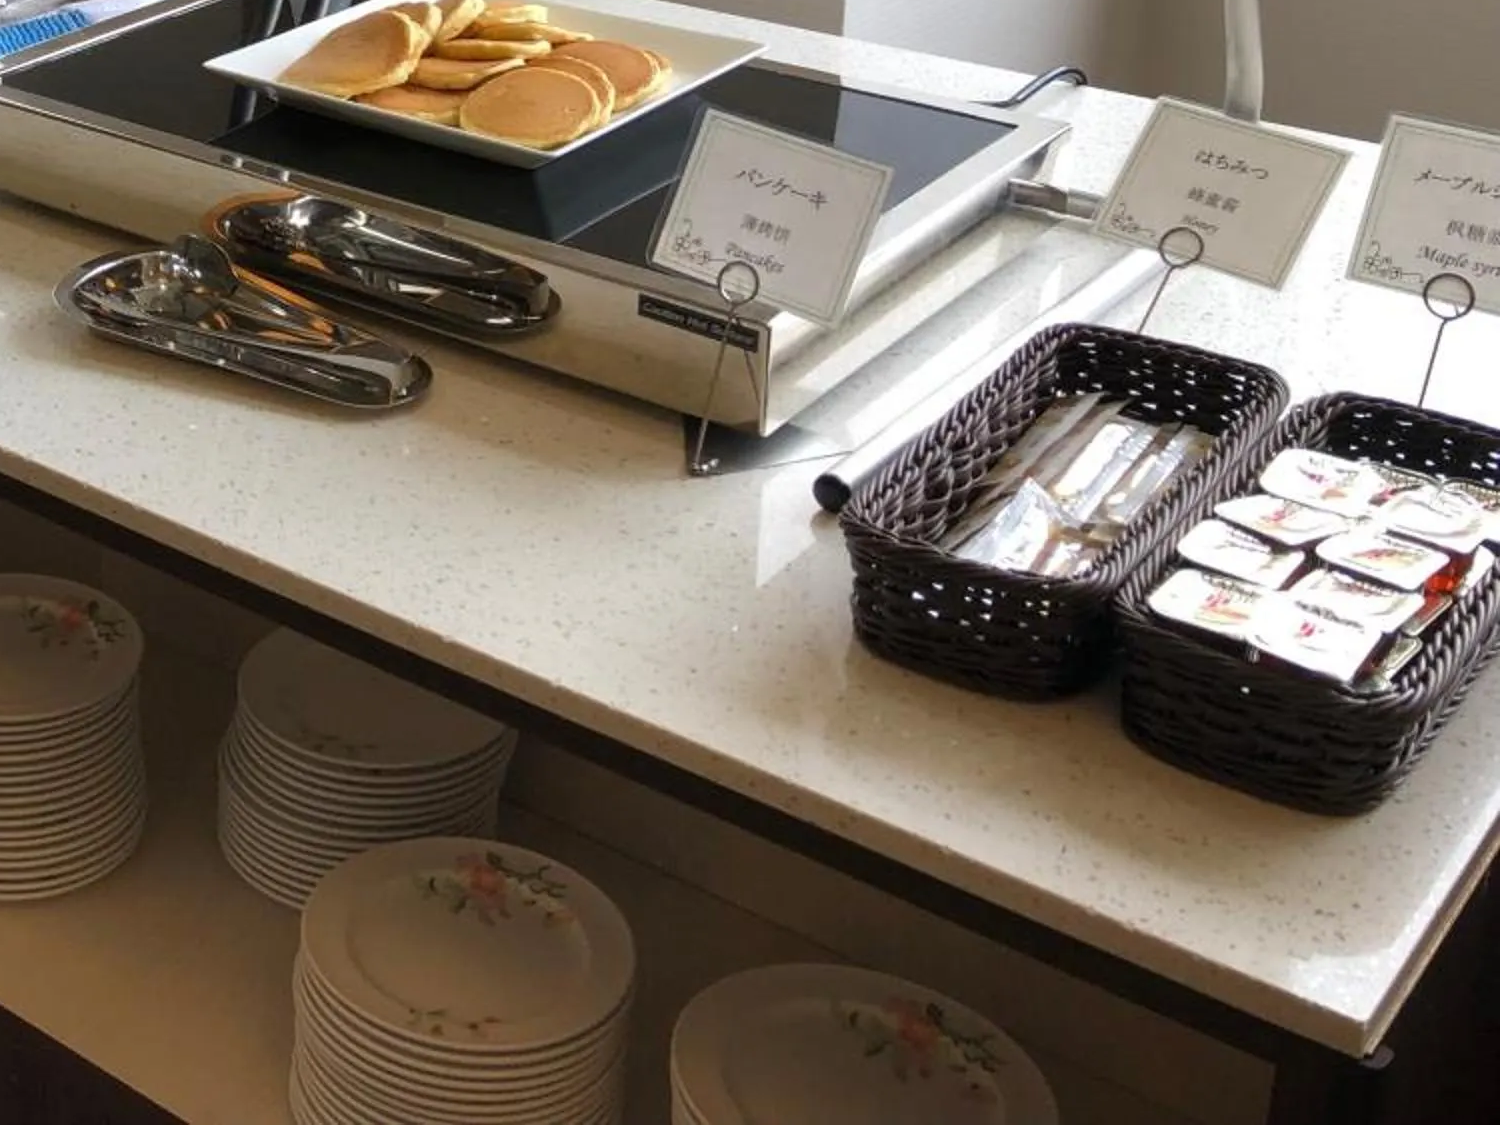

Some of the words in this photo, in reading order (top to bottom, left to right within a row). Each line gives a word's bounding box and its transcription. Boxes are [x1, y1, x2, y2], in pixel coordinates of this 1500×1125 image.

[1194, 150, 1270, 181] はちみつ
[734, 167, 828, 212] パンケーキ
[1415, 245, 1470, 270] Maple
